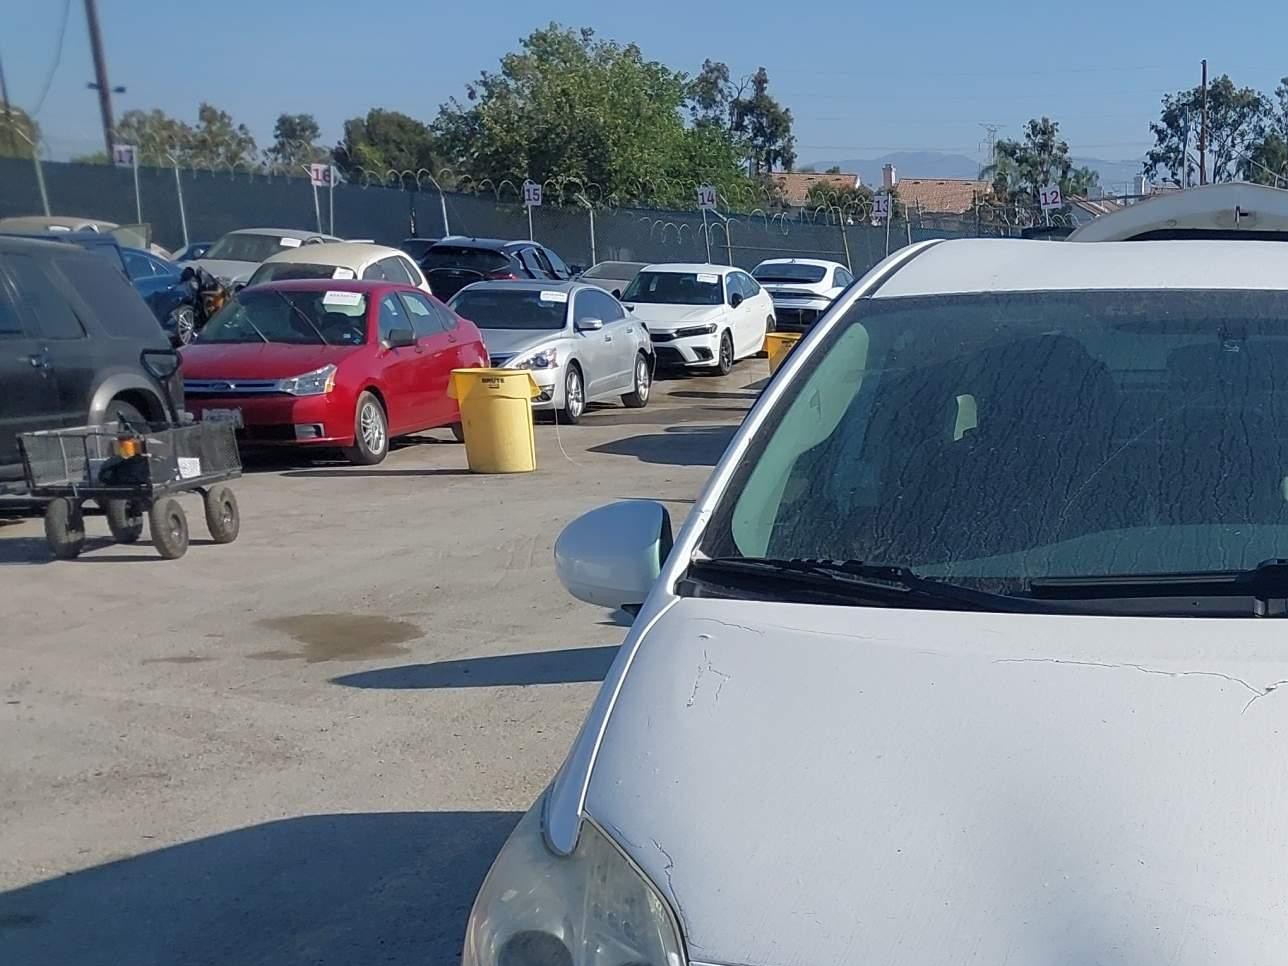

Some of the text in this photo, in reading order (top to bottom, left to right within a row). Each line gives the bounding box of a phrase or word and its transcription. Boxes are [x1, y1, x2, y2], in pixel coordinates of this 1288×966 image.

[313, 168, 336, 183] 16
[525, 187, 540, 202] 15
[700, 190, 715, 205] 14
[1042, 190, 1059, 206] 12
